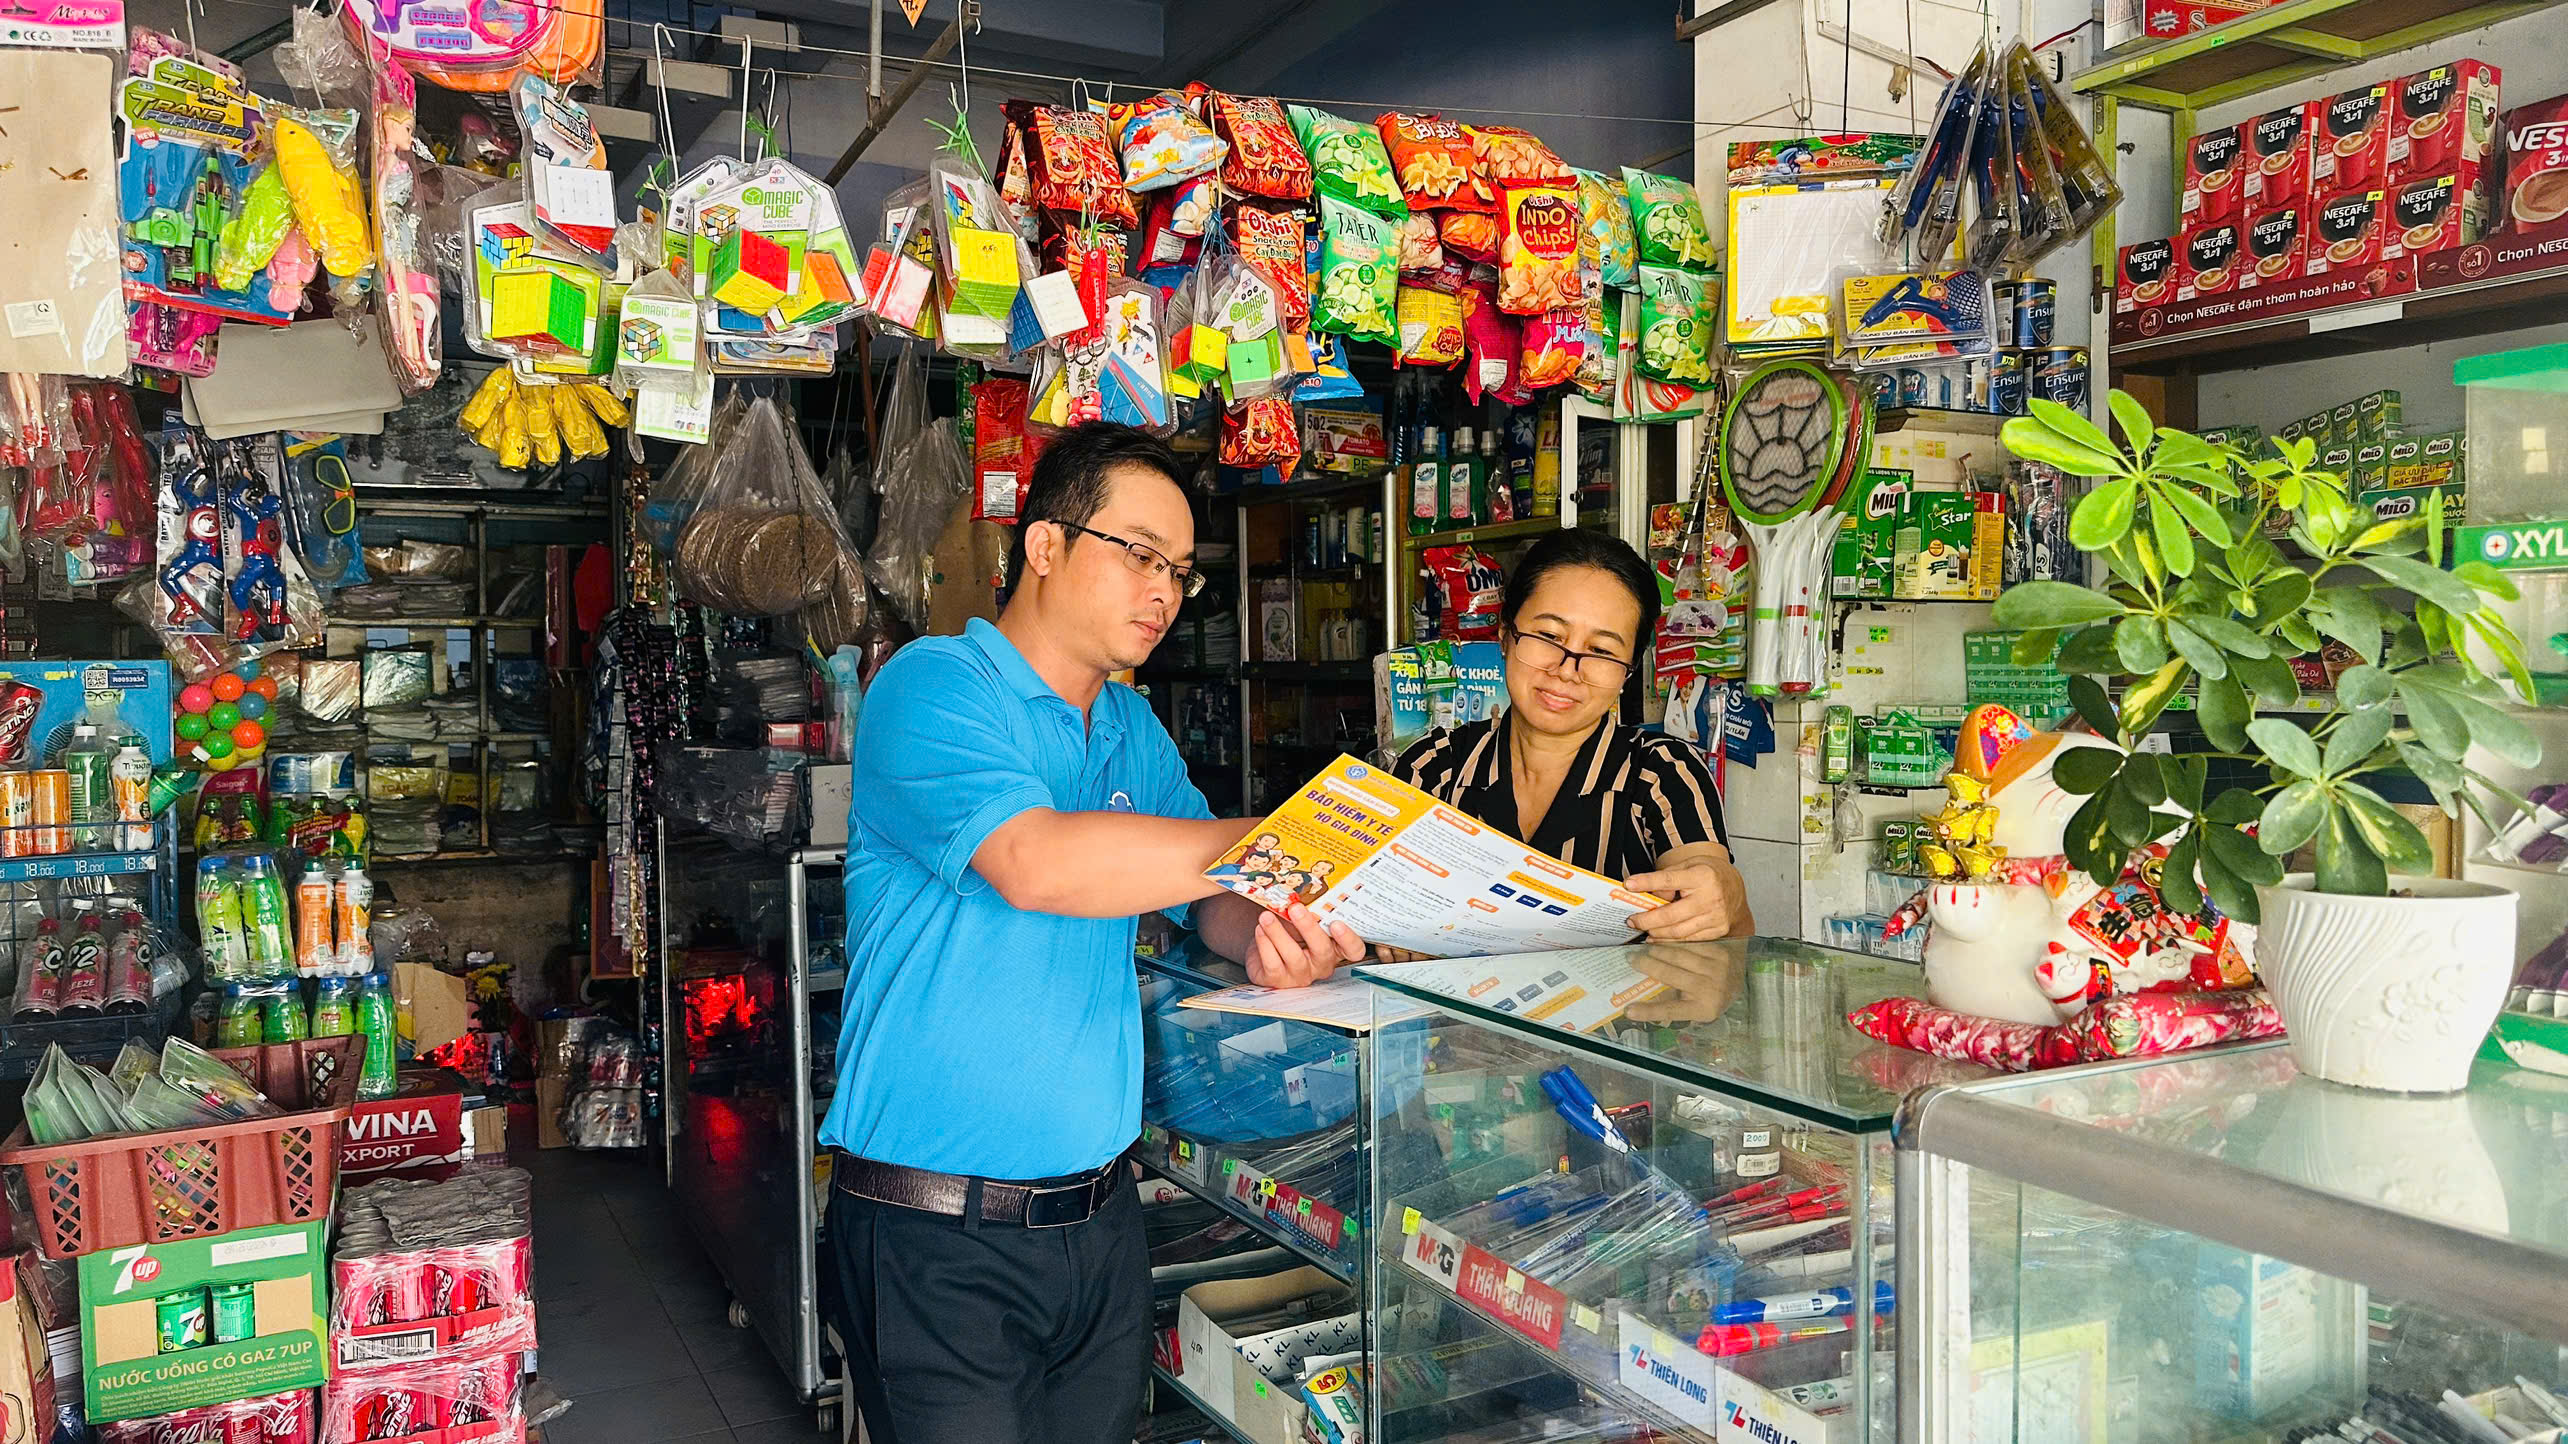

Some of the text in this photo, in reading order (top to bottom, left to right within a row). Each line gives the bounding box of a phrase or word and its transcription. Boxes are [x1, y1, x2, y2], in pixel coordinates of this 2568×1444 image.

[129, 92, 226, 122] TRANS
[142, 110, 251, 140] FORMERS
[137, 131, 155, 141] NEW
[764, 190, 804, 205] MAGIC
[763, 205, 793, 219] CUBE
[1521, 204, 1566, 226] INDO
[1248, 211, 1294, 236] Oishi
[1336, 212, 1379, 244] TATER
[1523, 217, 1576, 250] Chips!
[2497, 246, 2534, 263] Chọn
[643, 304, 670, 317] MAGIC
[1242, 290, 1268, 319] MAGIC
[2167, 310, 2194, 326] Chọn
[2238, 298, 2264, 312] đậm
[2266, 291, 2297, 306] thơm
[2299, 285, 2330, 299] hoàn
[2332, 278, 2356, 294] hảo
[1246, 308, 1266, 330] CUBE
[2045, 371, 2085, 388] Ensure
[1307, 414, 1326, 430] 502
[2327, 452, 2347, 463] MILO
[2361, 450, 2380, 460] MILO
[2394, 446, 2415, 456] MILO
[2428, 442, 2452, 453] MILO
[1942, 511, 1972, 526] Star
[2376, 502, 2410, 516] MILO
[2512, 527, 2568, 559] XYL
[1466, 568, 1506, 593] OM
[1468, 666, 1504, 682] KHOẺ,
[1306, 790, 1334, 806] BẢO
[1333, 803, 1367, 824] HIỂM
[1366, 818, 1378, 828] Y
[1376, 823, 1398, 836] TẾ
[1314, 812, 1379, 847] HỘ GIA ĐÌNH
[1887, 827, 1906, 836] MILO
[348, 1108, 438, 1140] VINA
[1746, 1134, 1767, 1143] 2000
[343, 1144, 416, 1163] XPORT
[1236, 1174, 1264, 1207] M&G
[1274, 1192, 1298, 1224] THẦN
[1416, 1232, 1454, 1277] M&G
[1469, 1261, 1505, 1305] THẦN
[1304, 1330, 1320, 1347] KL
[1332, 1320, 1348, 1337] KL
[1274, 1340, 1291, 1358] KL
[100, 1340, 313, 1392] NƯỚC UỐNG CÓ GAZ 7UP
[1286, 1354, 1302, 1371] KL
[1650, 1358, 1708, 1405] THIÊN LONG
[1748, 1416, 1782, 1444] THIÊN
